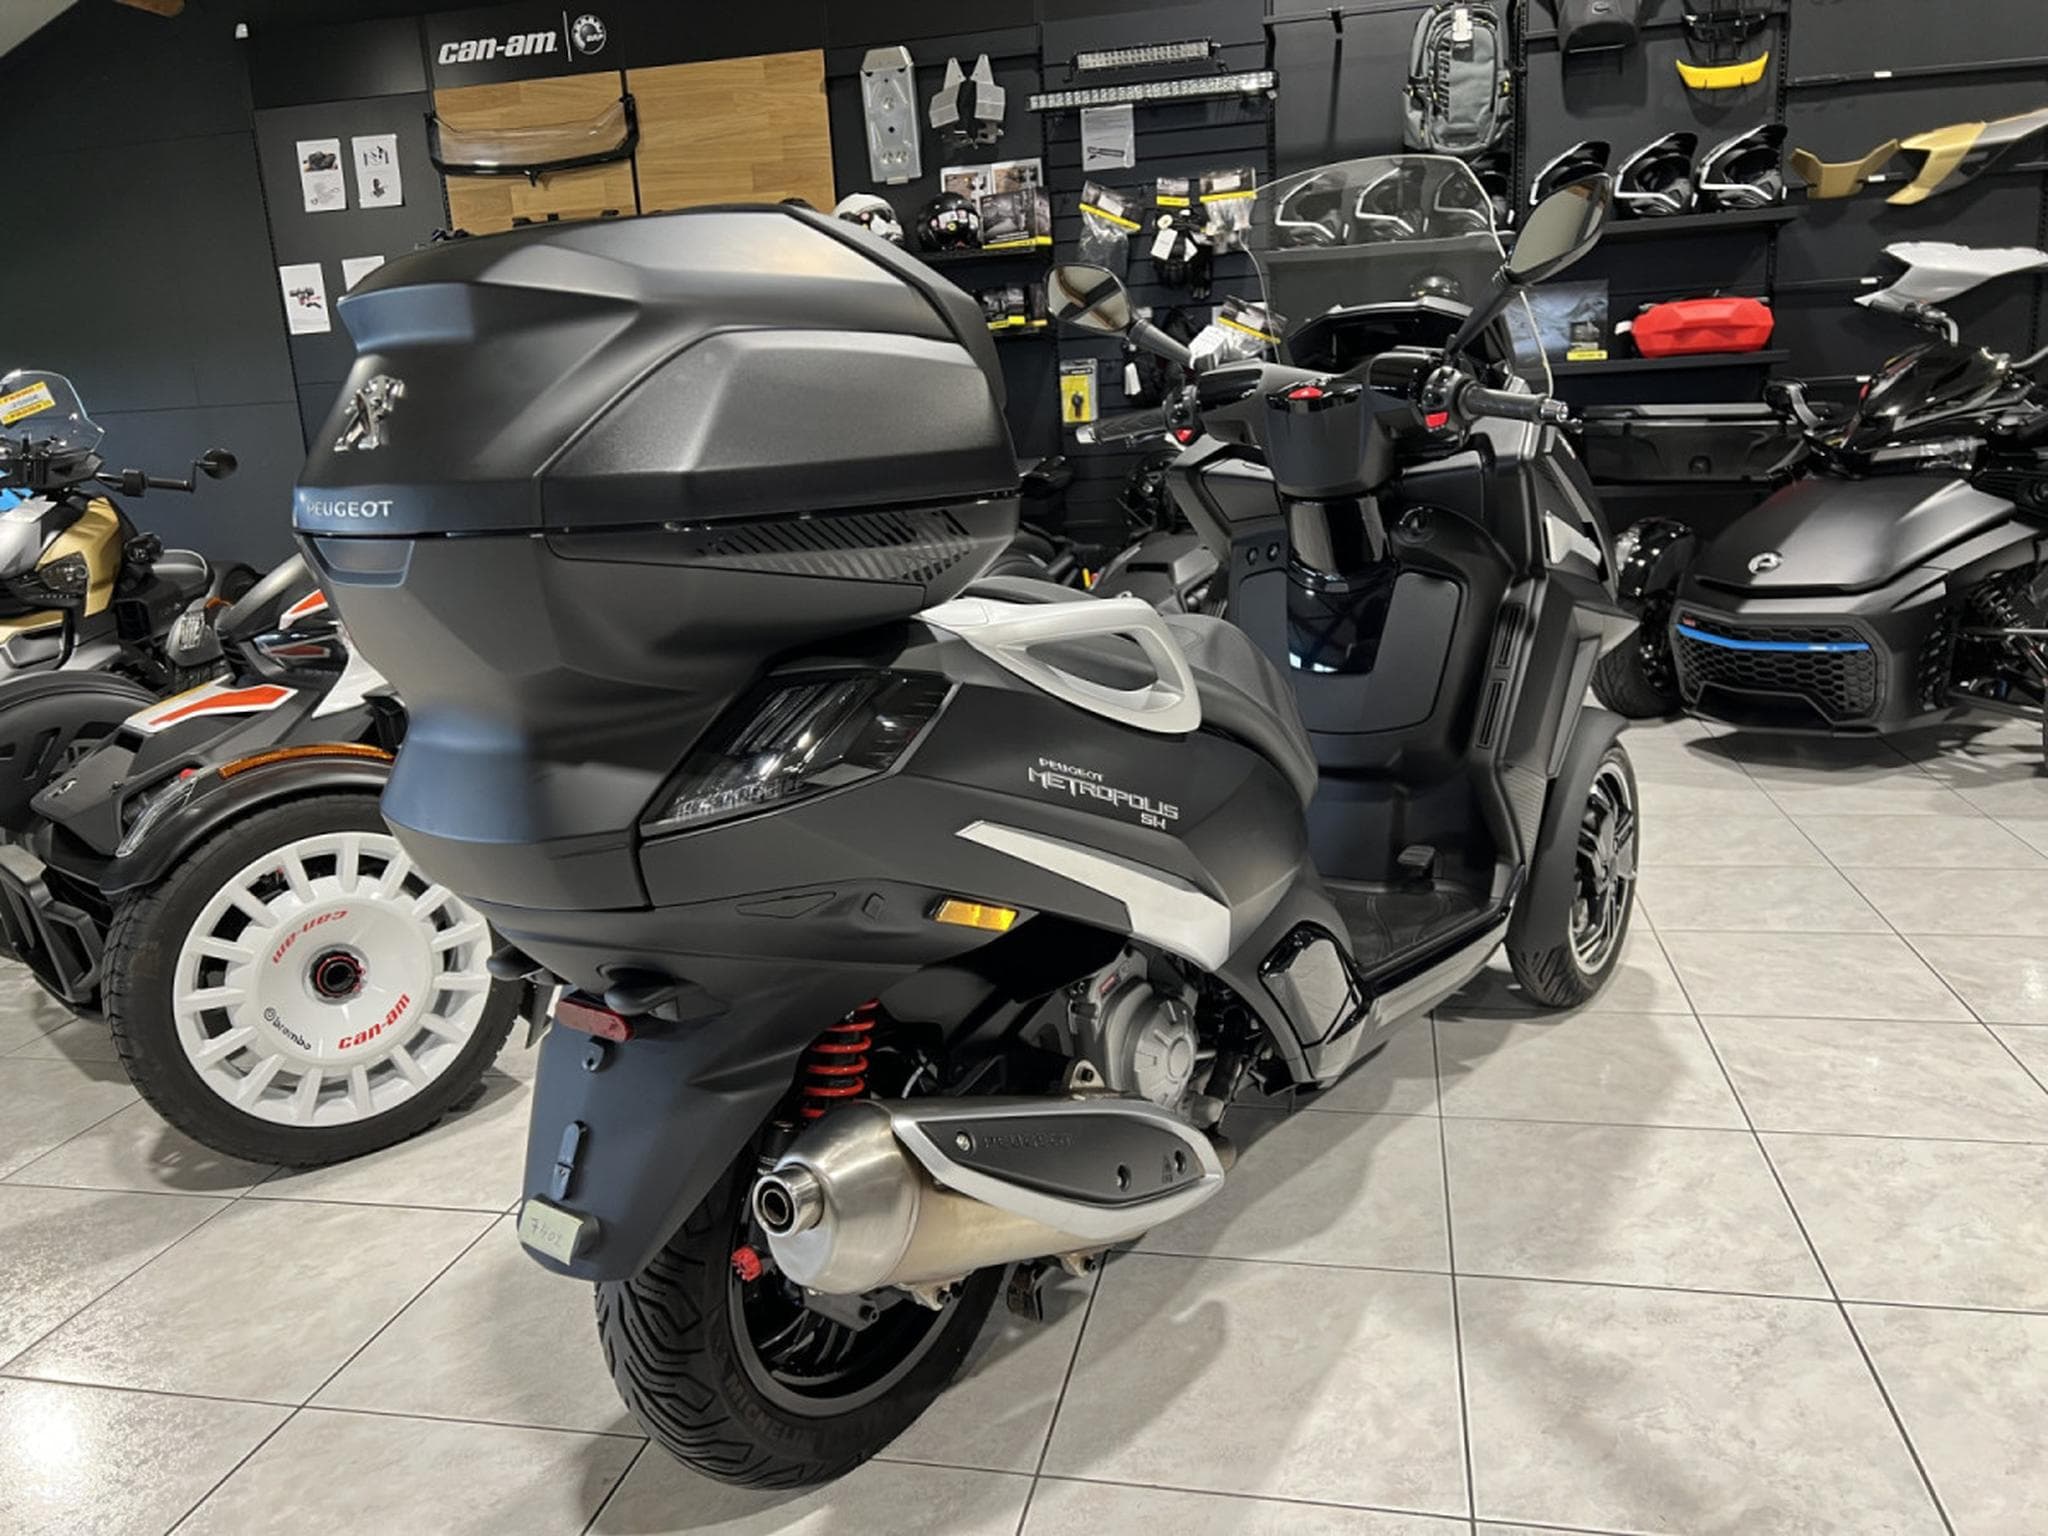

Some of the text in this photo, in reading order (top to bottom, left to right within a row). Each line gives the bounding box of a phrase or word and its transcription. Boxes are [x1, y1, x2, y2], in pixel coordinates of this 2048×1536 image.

[438, 31, 557, 65] can-am
[306, 500, 394, 518] PEUGEOT
[1038, 757, 1104, 782] PEUGEOT
[1028, 767, 1179, 820] METROPOLIS
[272, 910, 348, 964] can-am
[273, 1016, 312, 1051] brembo
[338, 993, 411, 1049] can-am
